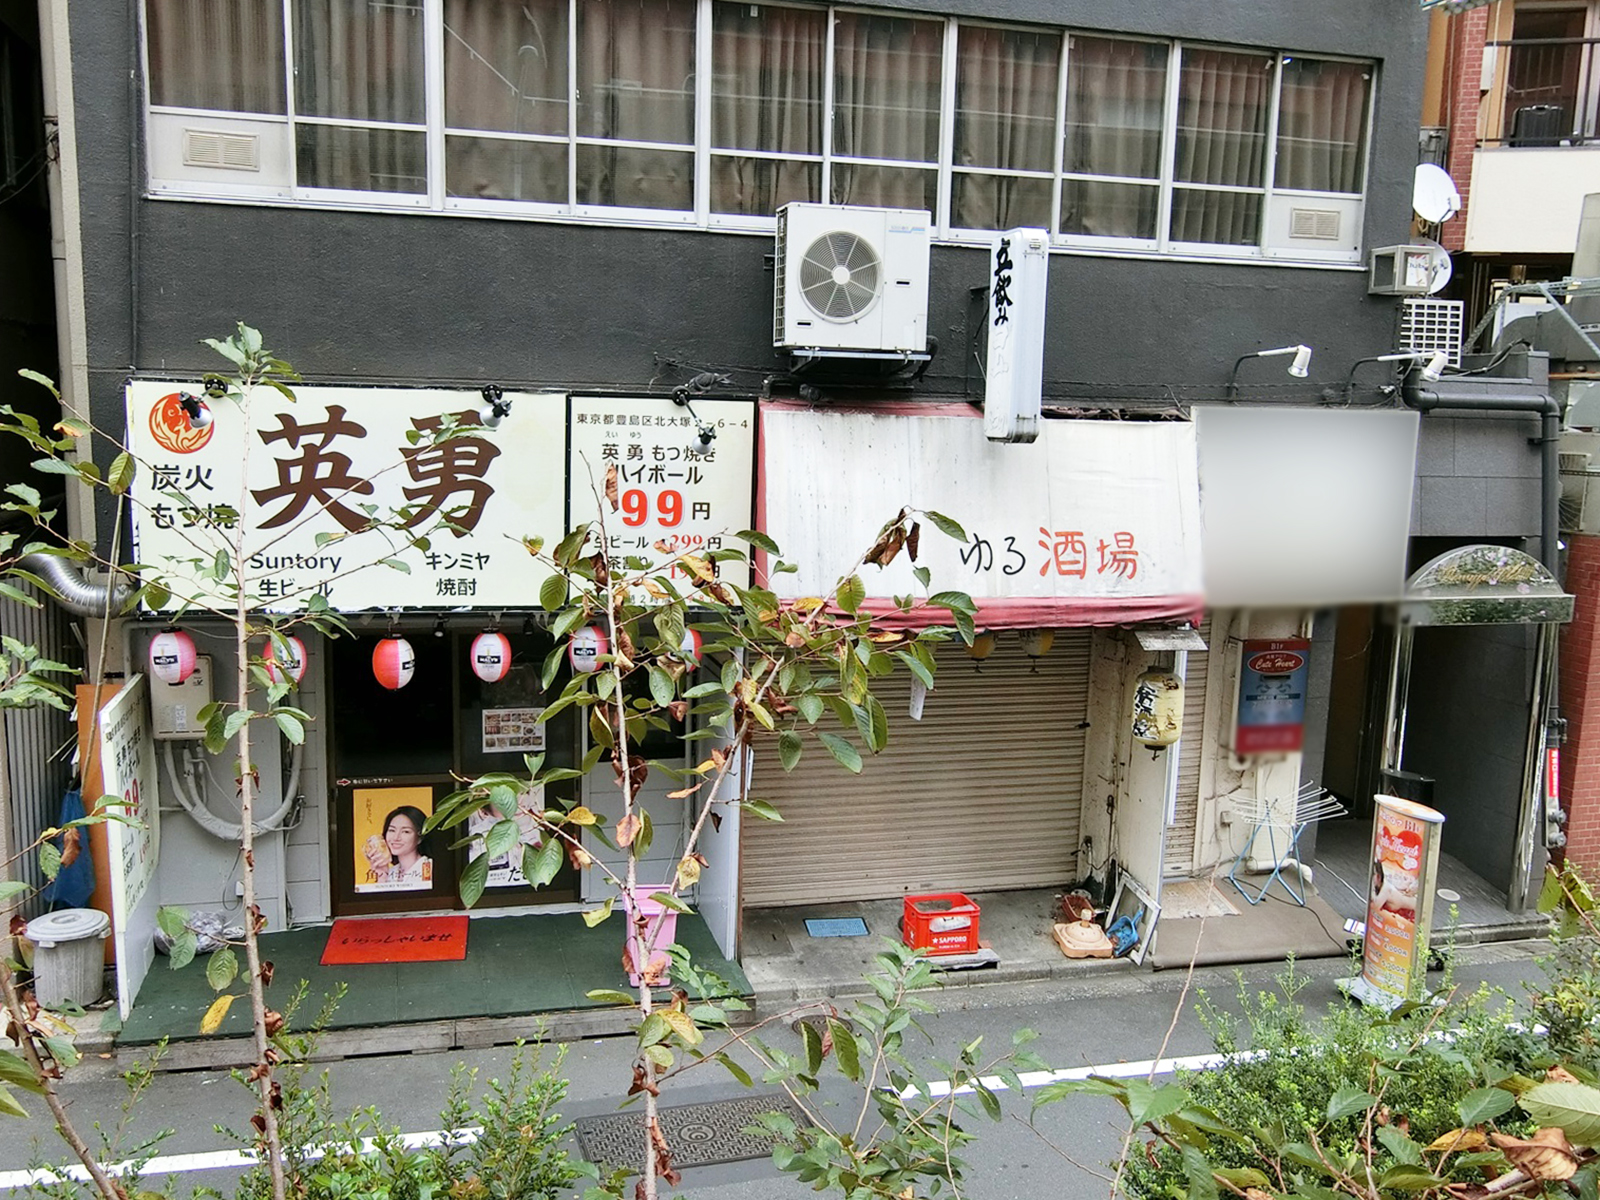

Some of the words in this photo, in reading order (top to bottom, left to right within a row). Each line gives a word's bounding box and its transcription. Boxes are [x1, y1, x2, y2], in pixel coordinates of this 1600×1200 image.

[150, 464, 214, 492] 炭火
[250, 404, 502, 538] 英勇
[593, 535, 650, 550] 生ビール
[959, 526, 1139, 580] ゆる酒場
[249, 552, 343, 574] Suntory
[425, 551, 492, 571] キンミヤ
[258, 577, 334, 599] 生ビール
[435, 578, 477, 597] 焼酎
[938, 935, 968, 944] SAPPORO
